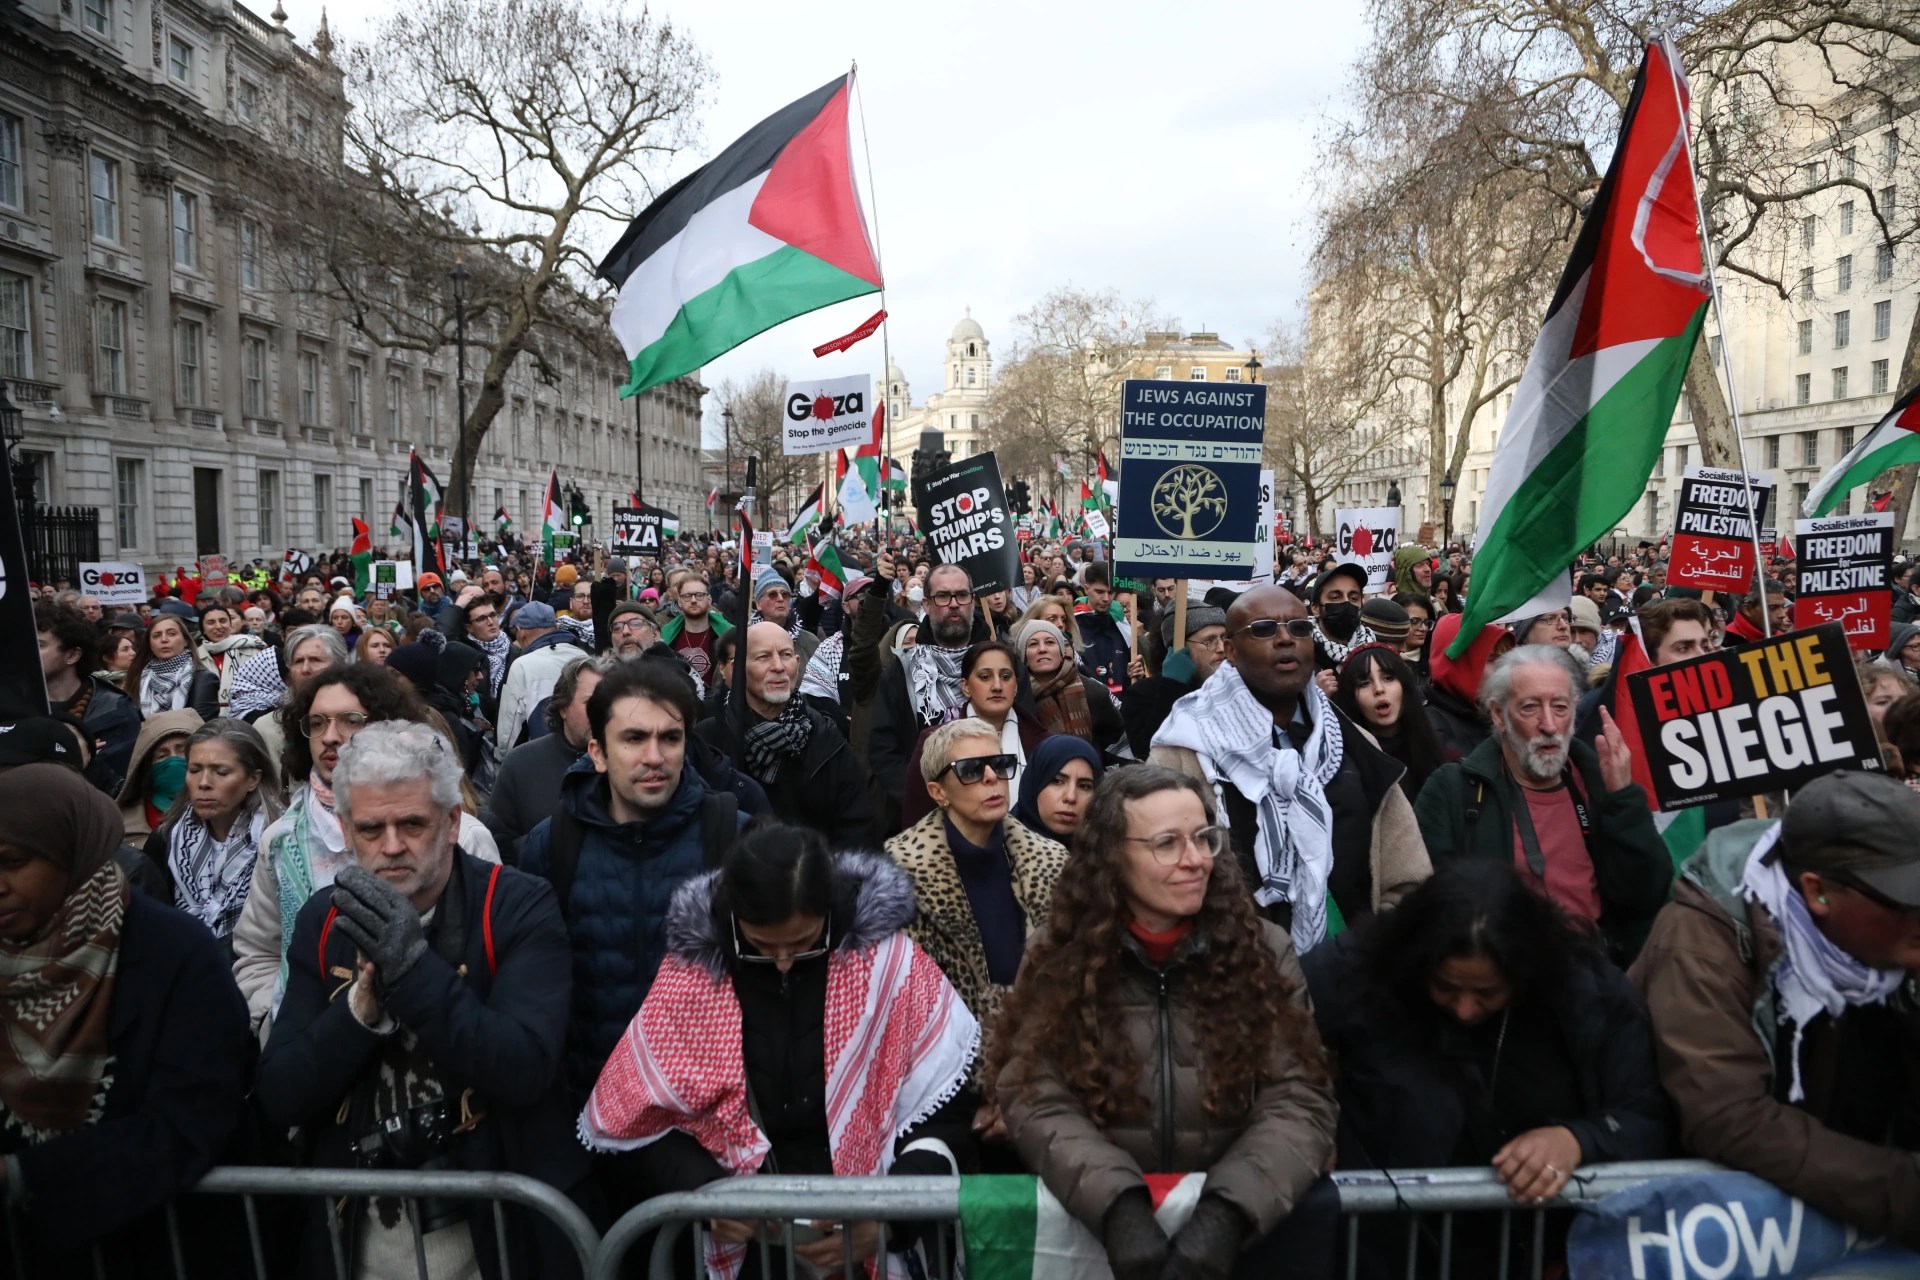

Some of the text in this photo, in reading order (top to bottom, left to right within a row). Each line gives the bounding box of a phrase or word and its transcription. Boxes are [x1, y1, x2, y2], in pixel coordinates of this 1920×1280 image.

[787, 392, 864, 421] Gza
[1137, 389, 1255, 407] JEWS AGAINST
[788, 420, 867, 439] Stop the genocide
[1125, 411, 1263, 430] THE OCCUPATION
[1124, 442, 1261, 460] יהודים נגד הכיבוש
[932, 479, 943, 488] Stop
[949, 472, 960, 480] War
[960, 465, 984, 476] coalition
[1698, 470, 1759, 485] Socialist Woker
[1689, 483, 1760, 509] FREEDOM
[930, 487, 990, 526] STOP
[1719, 505, 1731, 516] for
[622, 512, 659, 525] Starving
[929, 507, 1004, 546] TRUMP'S
[1681, 512, 1758, 538] PALESTIN
[1811, 518, 1878, 532] Socialist Worker
[937, 527, 1005, 564] WARS
[1340, 523, 1396, 556] Gza
[1805, 533, 1882, 560] FREEDOM
[1188, 548, 1210, 558] ضد
[1215, 550, 1241, 563] يهود
[1690, 540, 1741, 562] الحرية
[1367, 563, 1389, 576] genoc
[1680, 561, 1743, 579] لفلسطين
[1838, 557, 1851, 568] for
[83, 569, 139, 586] Gza
[1113, 576, 1147, 592] Palesine
[1801, 565, 1885, 593] PALESTINE
[85, 589, 98, 597] Stop
[110, 589, 142, 597] genocide
[1814, 597, 1867, 621] الحرية
[1648, 634, 1832, 722] END THE
[1660, 683, 1855, 790] SIEGE
[1861, 757, 1879, 770] FOA
[1627, 1197, 1804, 1280] HOW
